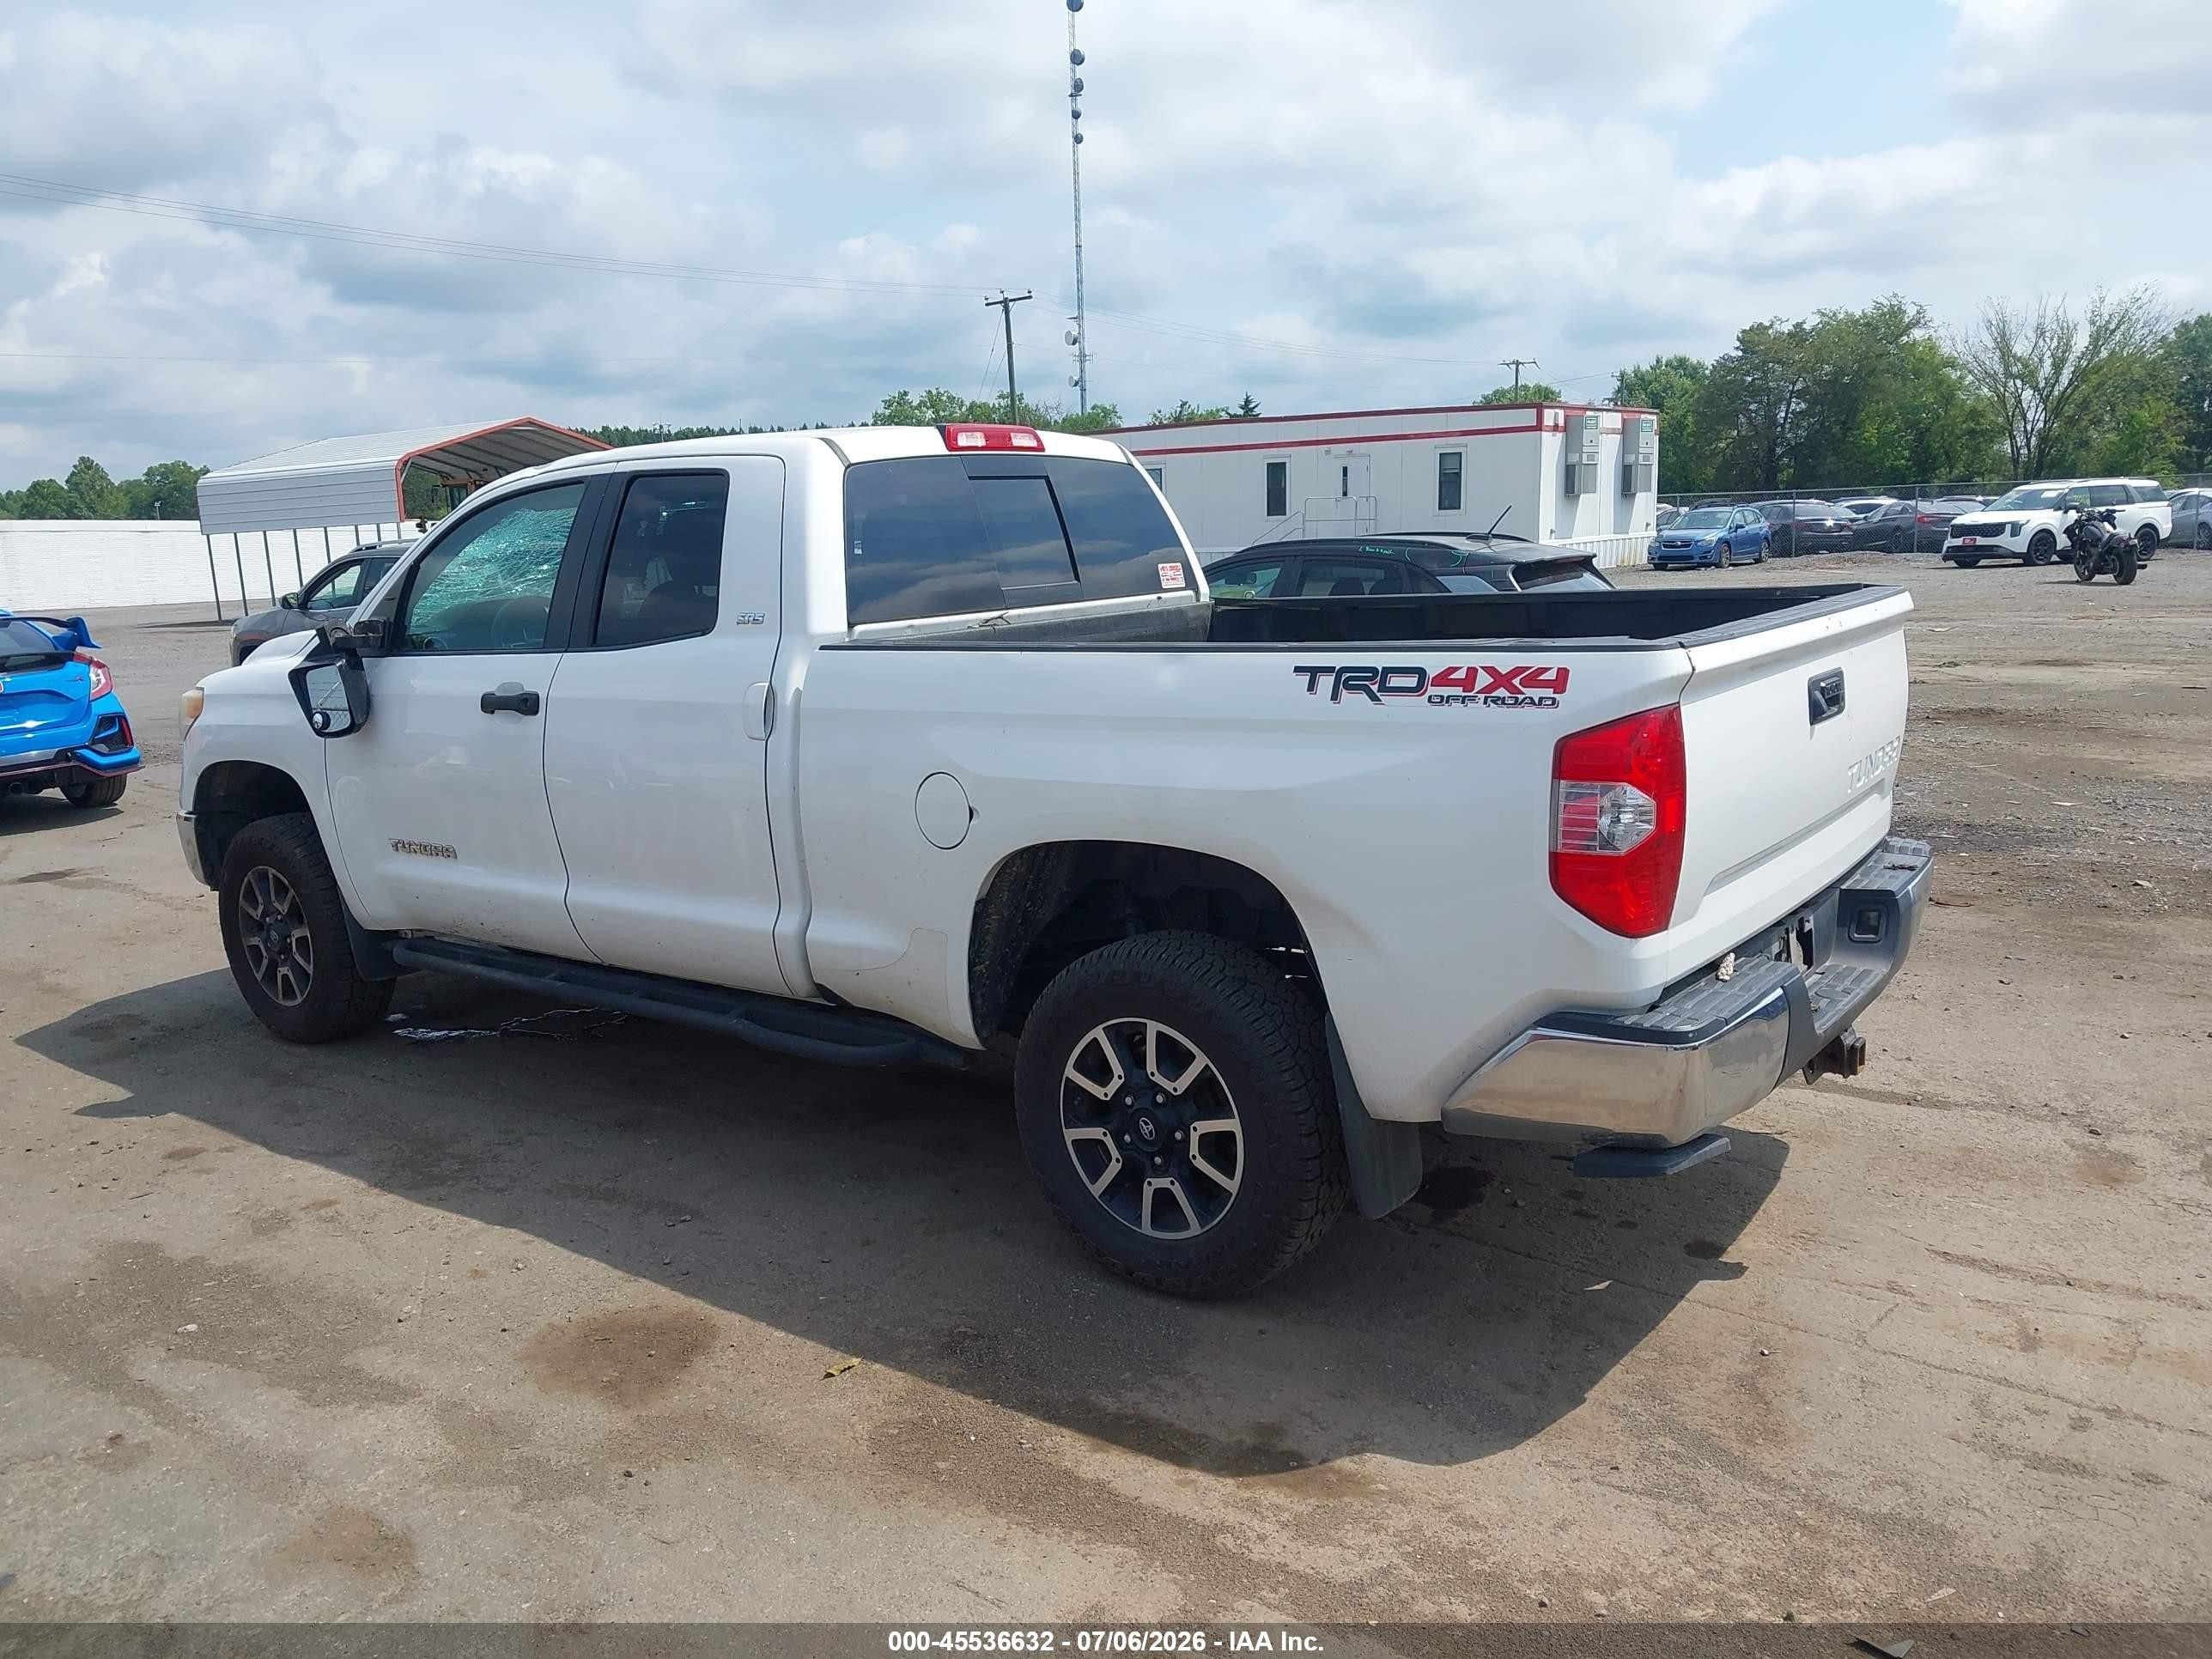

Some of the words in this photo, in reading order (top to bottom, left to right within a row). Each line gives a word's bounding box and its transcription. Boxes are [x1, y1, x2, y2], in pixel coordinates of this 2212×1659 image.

[1293, 665, 1431, 706] TRD
[1431, 665, 1571, 696] 4X4
[1427, 695, 1479, 708] OFF
[1483, 695, 1561, 709] ROAD
[1847, 735, 1901, 793] TUNDRA
[388, 837, 458, 860] TUNDRA
